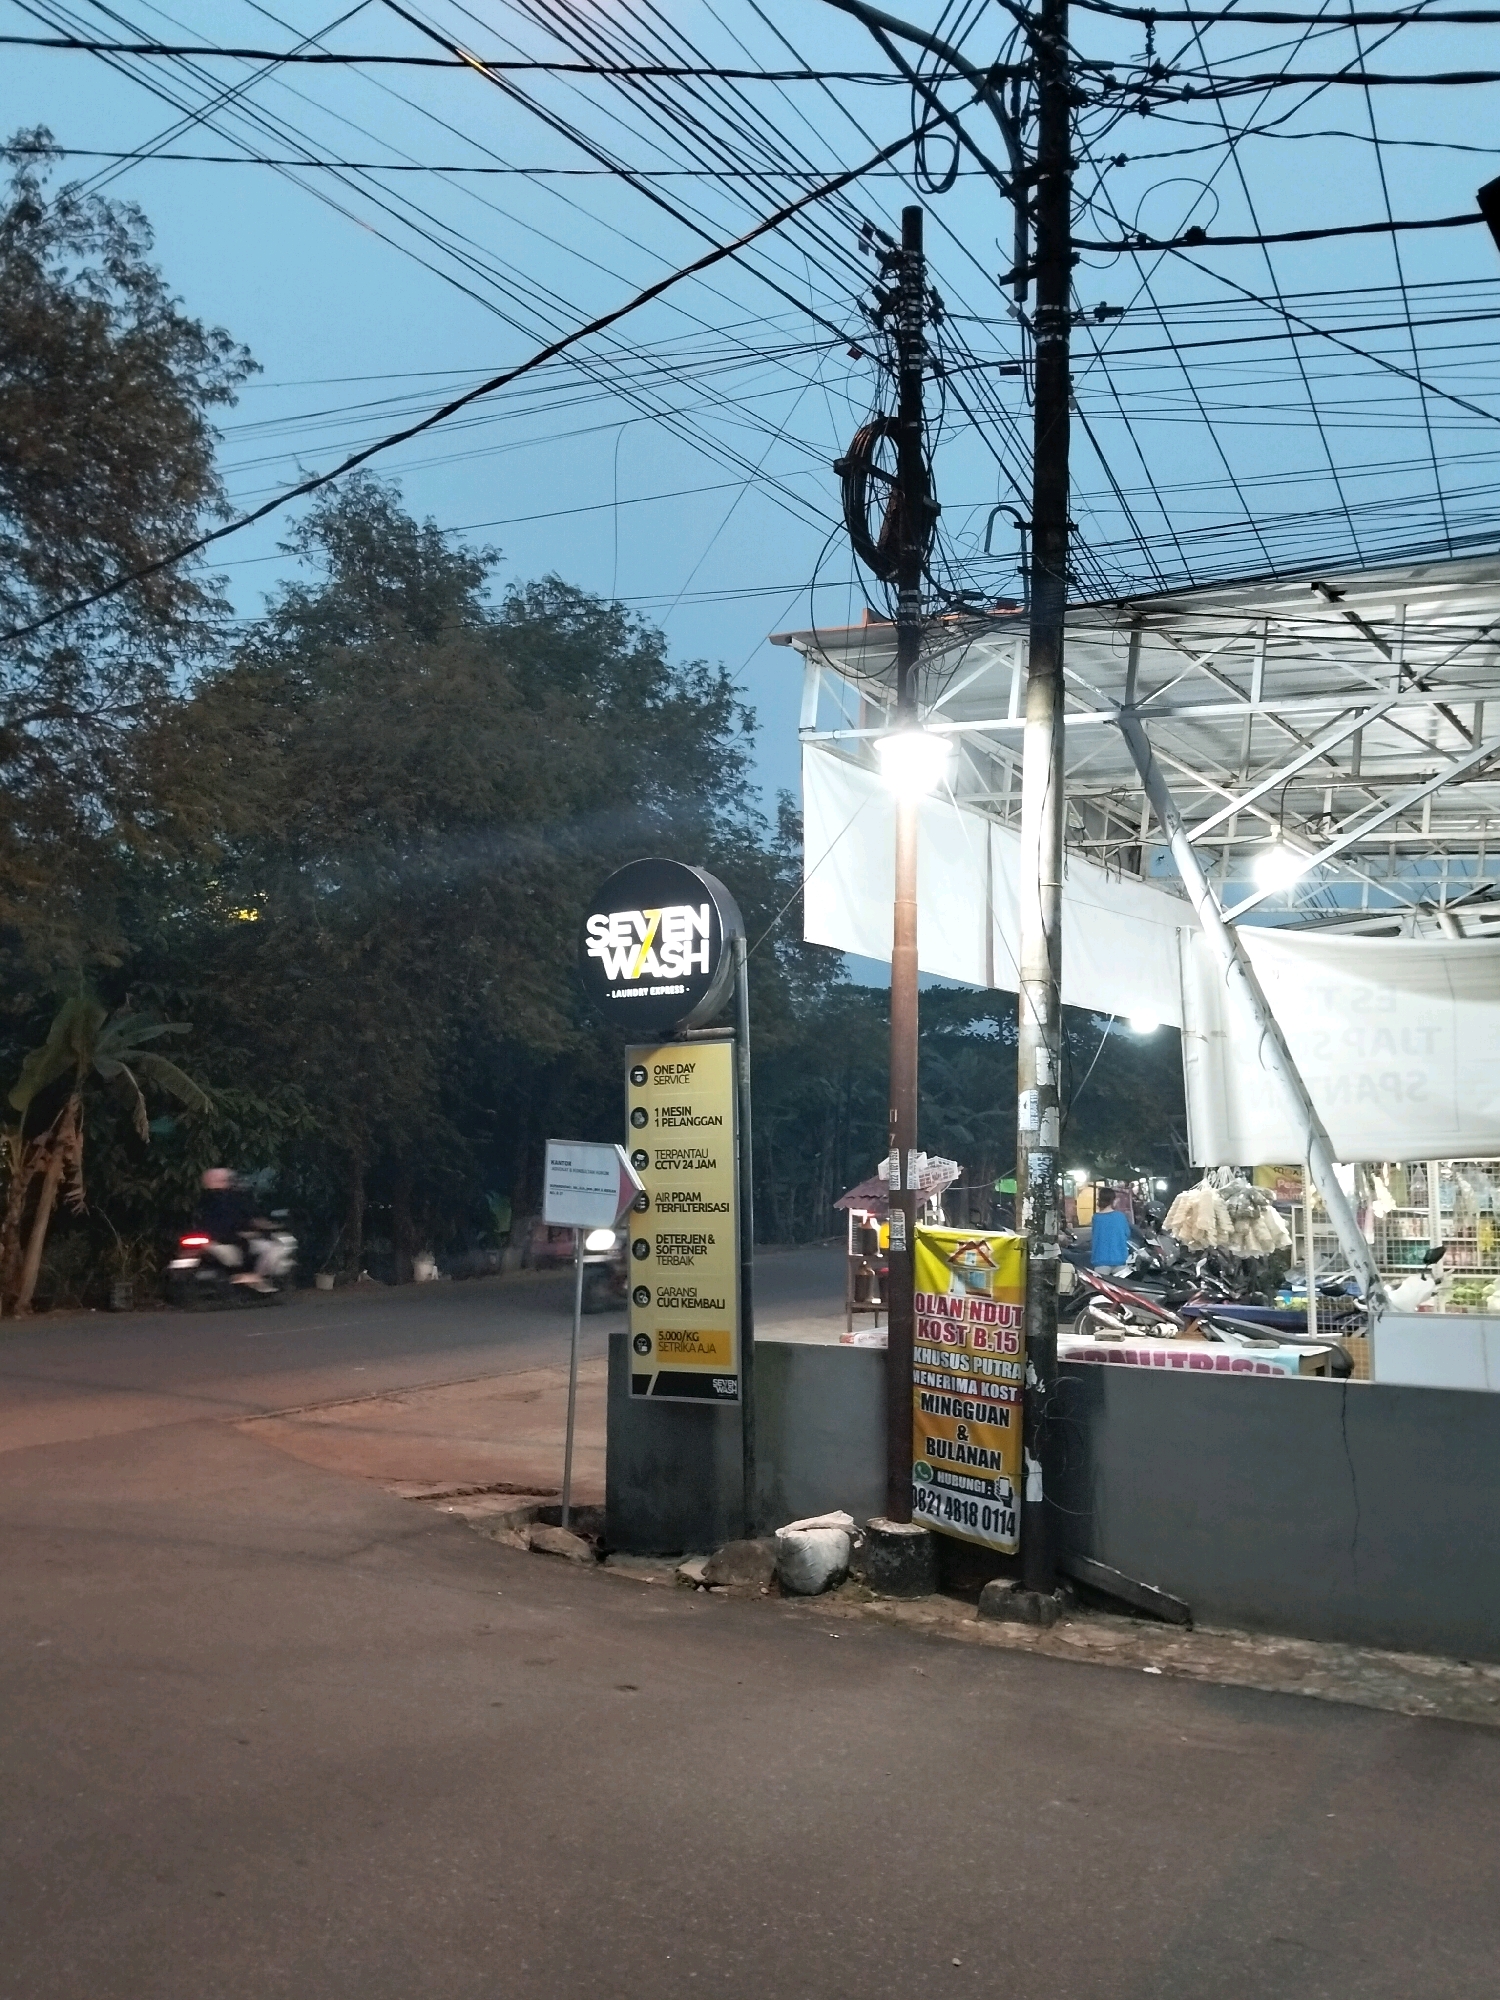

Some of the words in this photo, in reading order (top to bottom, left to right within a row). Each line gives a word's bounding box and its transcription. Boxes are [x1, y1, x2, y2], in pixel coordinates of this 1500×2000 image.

[587, 938, 710, 981] WASH
[611, 988, 649, 998] LAUNDRY
[649, 984, 685, 996] EXPRESS
[653, 1064, 675, 1075] ONE
[676, 1063, 696, 1074] DAY
[653, 1074, 691, 1086] SERVICE
[654, 1107, 660, 1117] 1
[661, 1106, 692, 1117] MESIN
[654, 1117, 660, 1127] 1
[661, 1116, 723, 1128] PELANGGAN
[654, 1148, 709, 1160] TERPANTAU
[654, 1159, 682, 1170] CCTV
[682, 1159, 694, 1170] 24
[695, 1158, 717, 1169] JAM
[655, 1192, 670, 1203] AIR
[671, 1191, 702, 1202] PDAM
[655, 1203, 730, 1213] TERFILTERISASI
[655, 1234, 707, 1245] DETERJEN
[708, 1234, 716, 1245] &
[655, 1244, 708, 1255] SOFTENER
[656, 1255, 695, 1266] TERBAIK
[656, 1286, 698, 1297] GARANSI
[656, 1297, 680, 1308] CUCI
[681, 1298, 726, 1310] KEMBALI
[914, 1293, 964, 1320] OLAN
[968, 1299, 1025, 1329] NDUT
[658, 1330, 700, 1342] 5.000/KG
[916, 1317, 969, 1347] KOST
[972, 1325, 1020, 1355] B.15
[658, 1341, 696, 1353] SETRIKA
[697, 1343, 717, 1354] AJA
[913, 1346, 970, 1372] KHUSUS
[973, 1356, 1022, 1380] PUTRA
[712, 1378, 737, 1388] SEVEN
[713, 1384, 738, 1395] WASH
[981, 1381, 1018, 1402] KOST
[920, 1391, 1010, 1428] MINGGUAN
[956, 1424, 969, 1442] &
[926, 1436, 1002, 1472] BULANAN
[944, 1496, 979, 1528] 4818
[982, 1504, 1016, 1537] 0114
